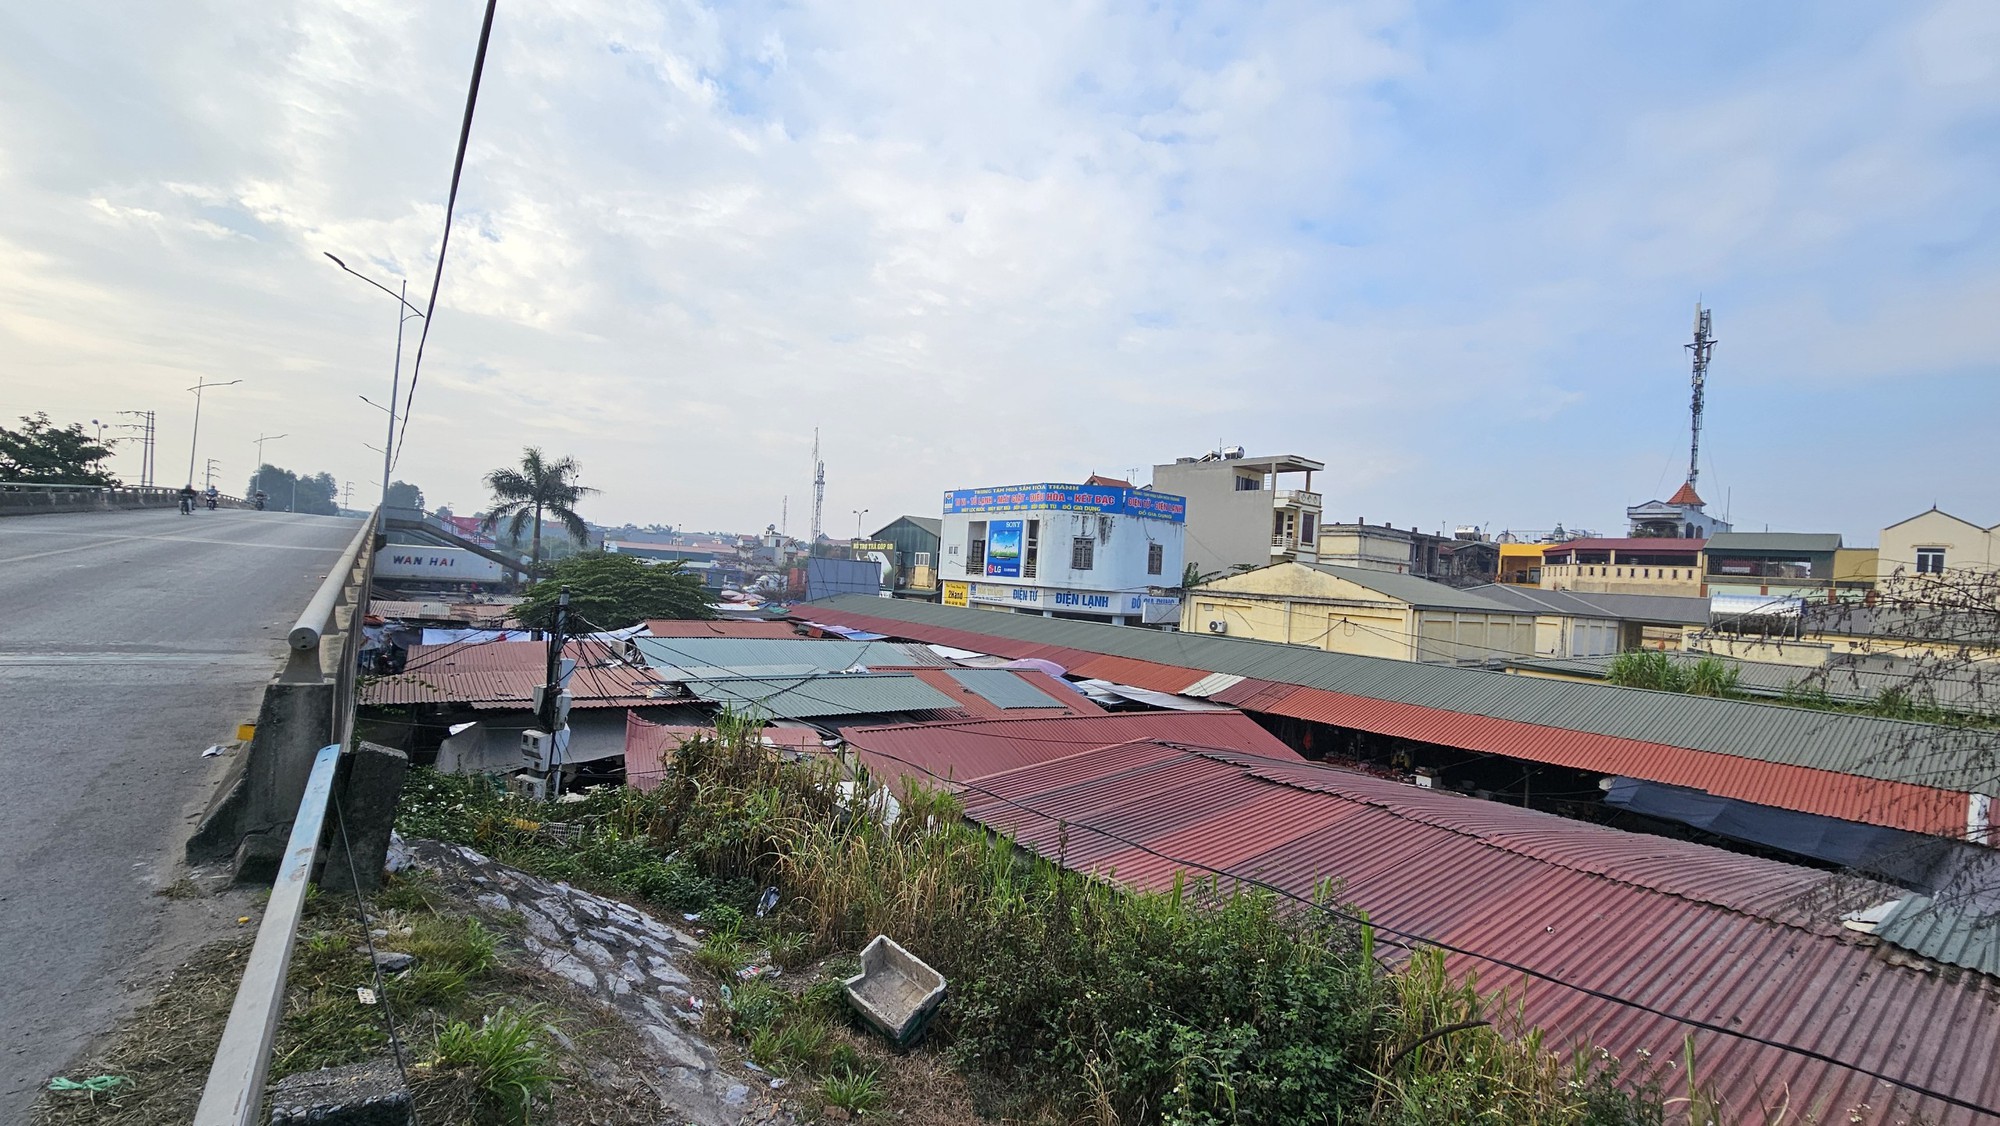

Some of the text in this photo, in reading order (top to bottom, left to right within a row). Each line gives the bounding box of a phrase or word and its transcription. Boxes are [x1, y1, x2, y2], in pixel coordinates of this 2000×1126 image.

[1095, 495, 1115, 506] BẠC
[393, 555, 455, 567] WAN HAI
[1012, 587, 1027, 603] ĐIỆN
[1029, 586, 1039, 602] TỬ
[1055, 591, 1079, 607] ĐIỆN
[1082, 595, 1109, 609] LẠNH
[1131, 593, 1141, 609] ĐỒ
